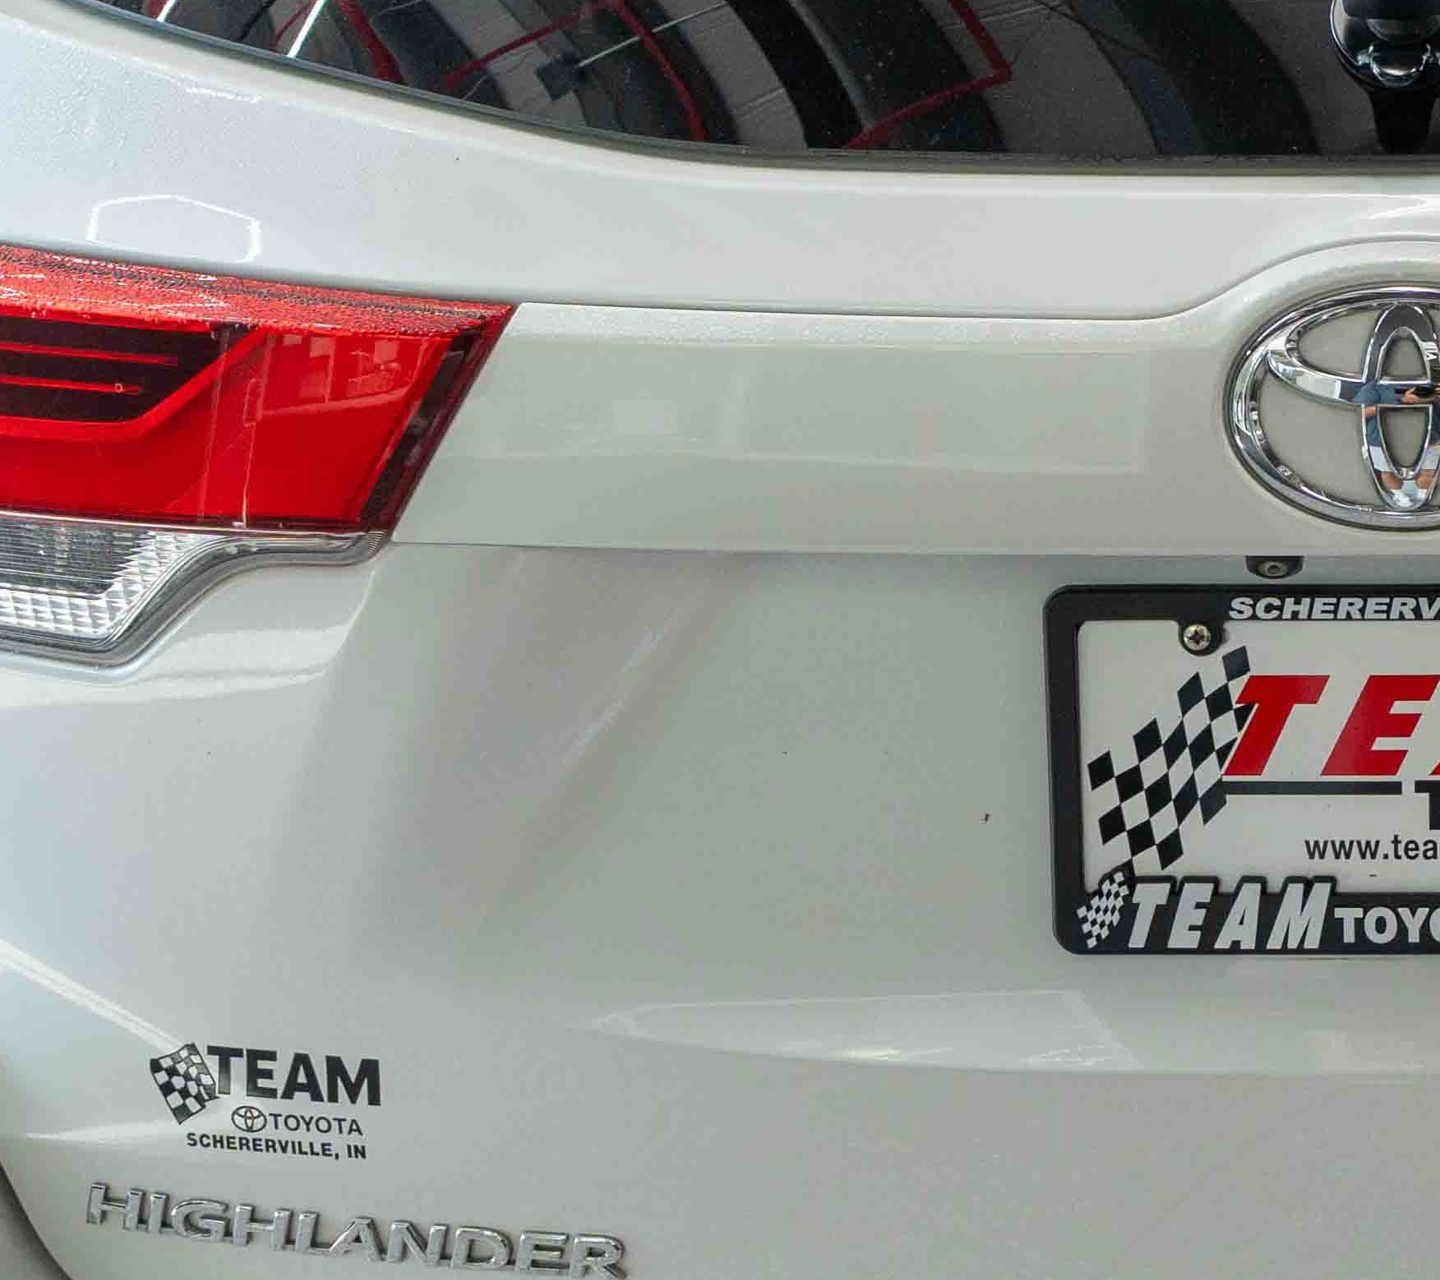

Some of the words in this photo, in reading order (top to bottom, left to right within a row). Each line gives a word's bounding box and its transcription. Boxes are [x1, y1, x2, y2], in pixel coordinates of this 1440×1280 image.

[1127, 880, 1332, 950] TEAM
[207, 1045, 381, 1106] TEAM
[186, 1132, 340, 1160] SCHERERVILLE,
[346, 1144, 367, 1160] IN
[269, 1112, 364, 1137] TOYOTA
[86, 1181, 629, 1280] HIGHLANDER
